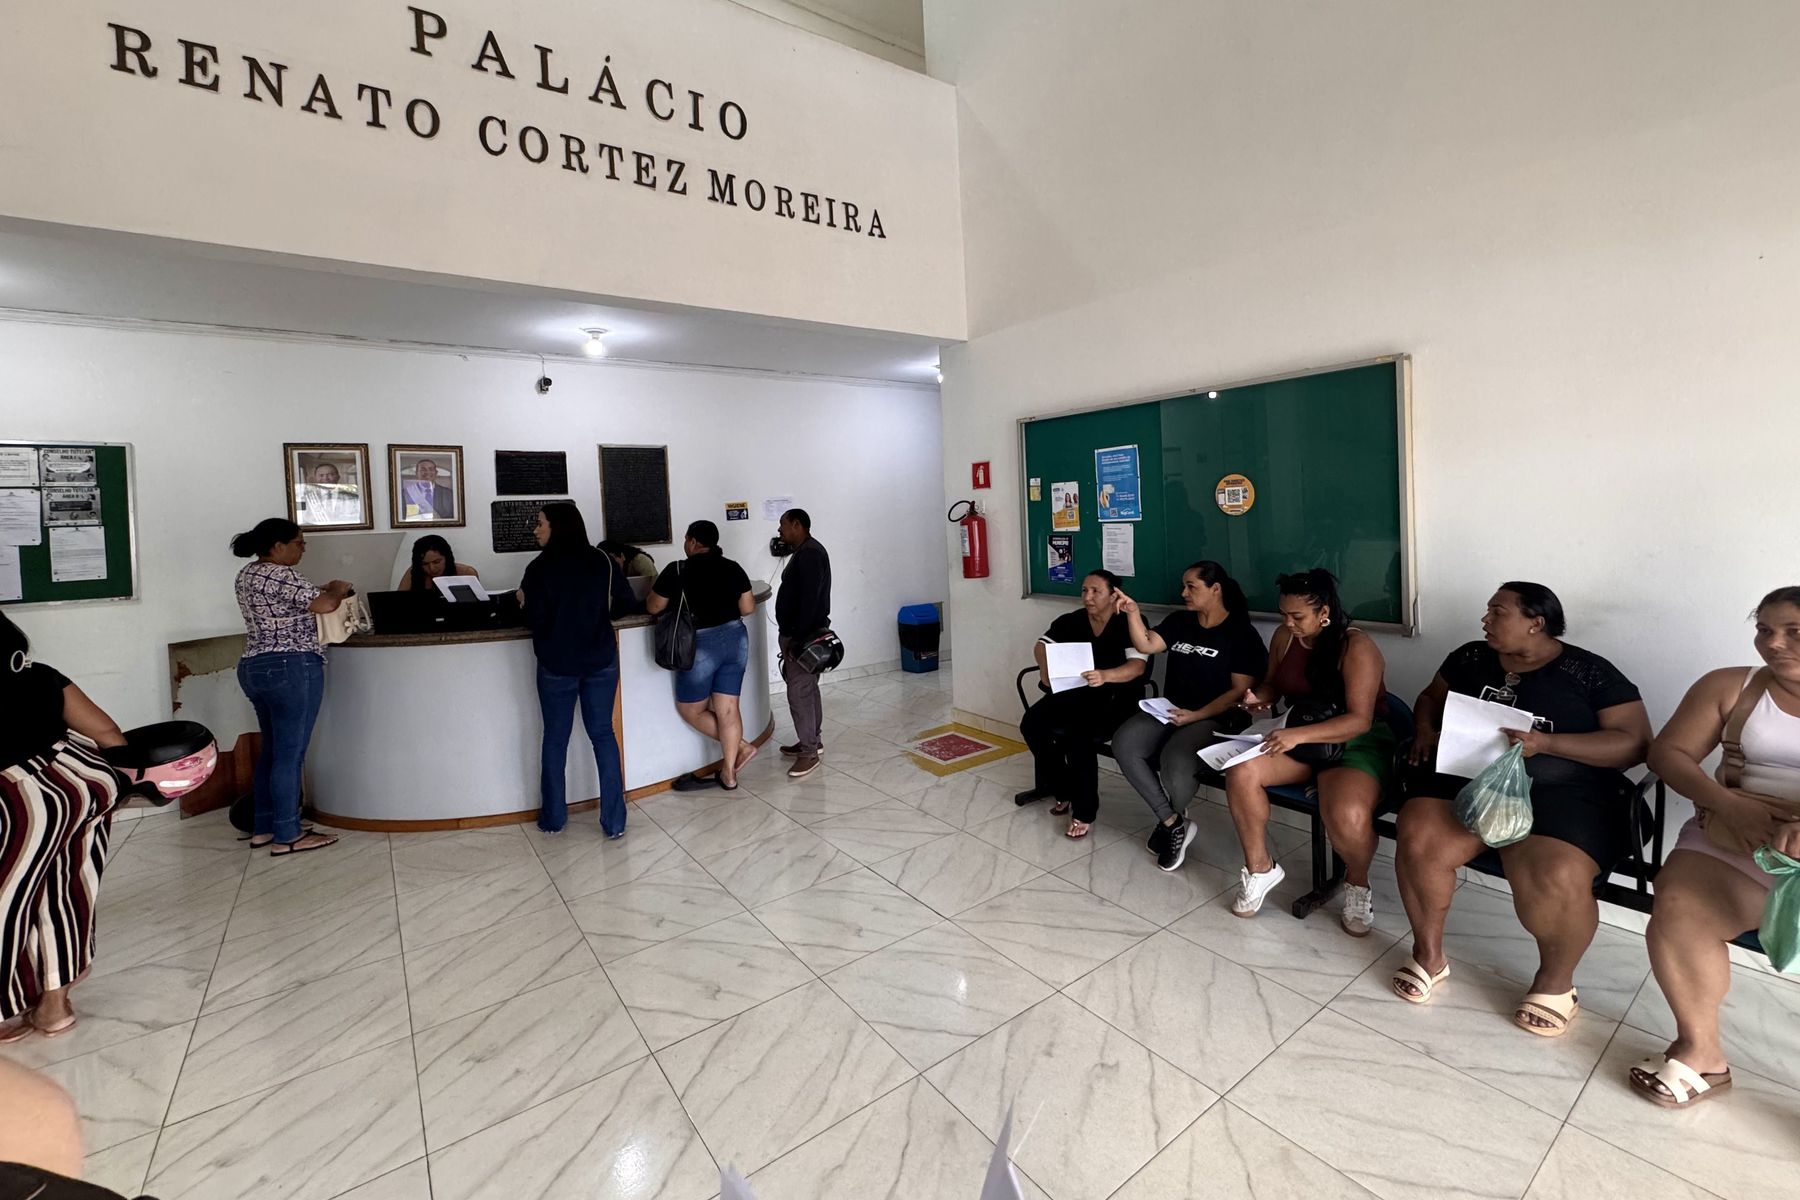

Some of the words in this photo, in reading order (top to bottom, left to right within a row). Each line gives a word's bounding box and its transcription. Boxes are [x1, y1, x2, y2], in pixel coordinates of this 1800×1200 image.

[107, 22, 442, 139] RENATO
[478, 115, 688, 196] CORTEZ
[707, 168, 887, 239] MOREIRA
[406, 5, 748, 141] PALÁCIO
[1171, 641, 1219, 658] HERO
